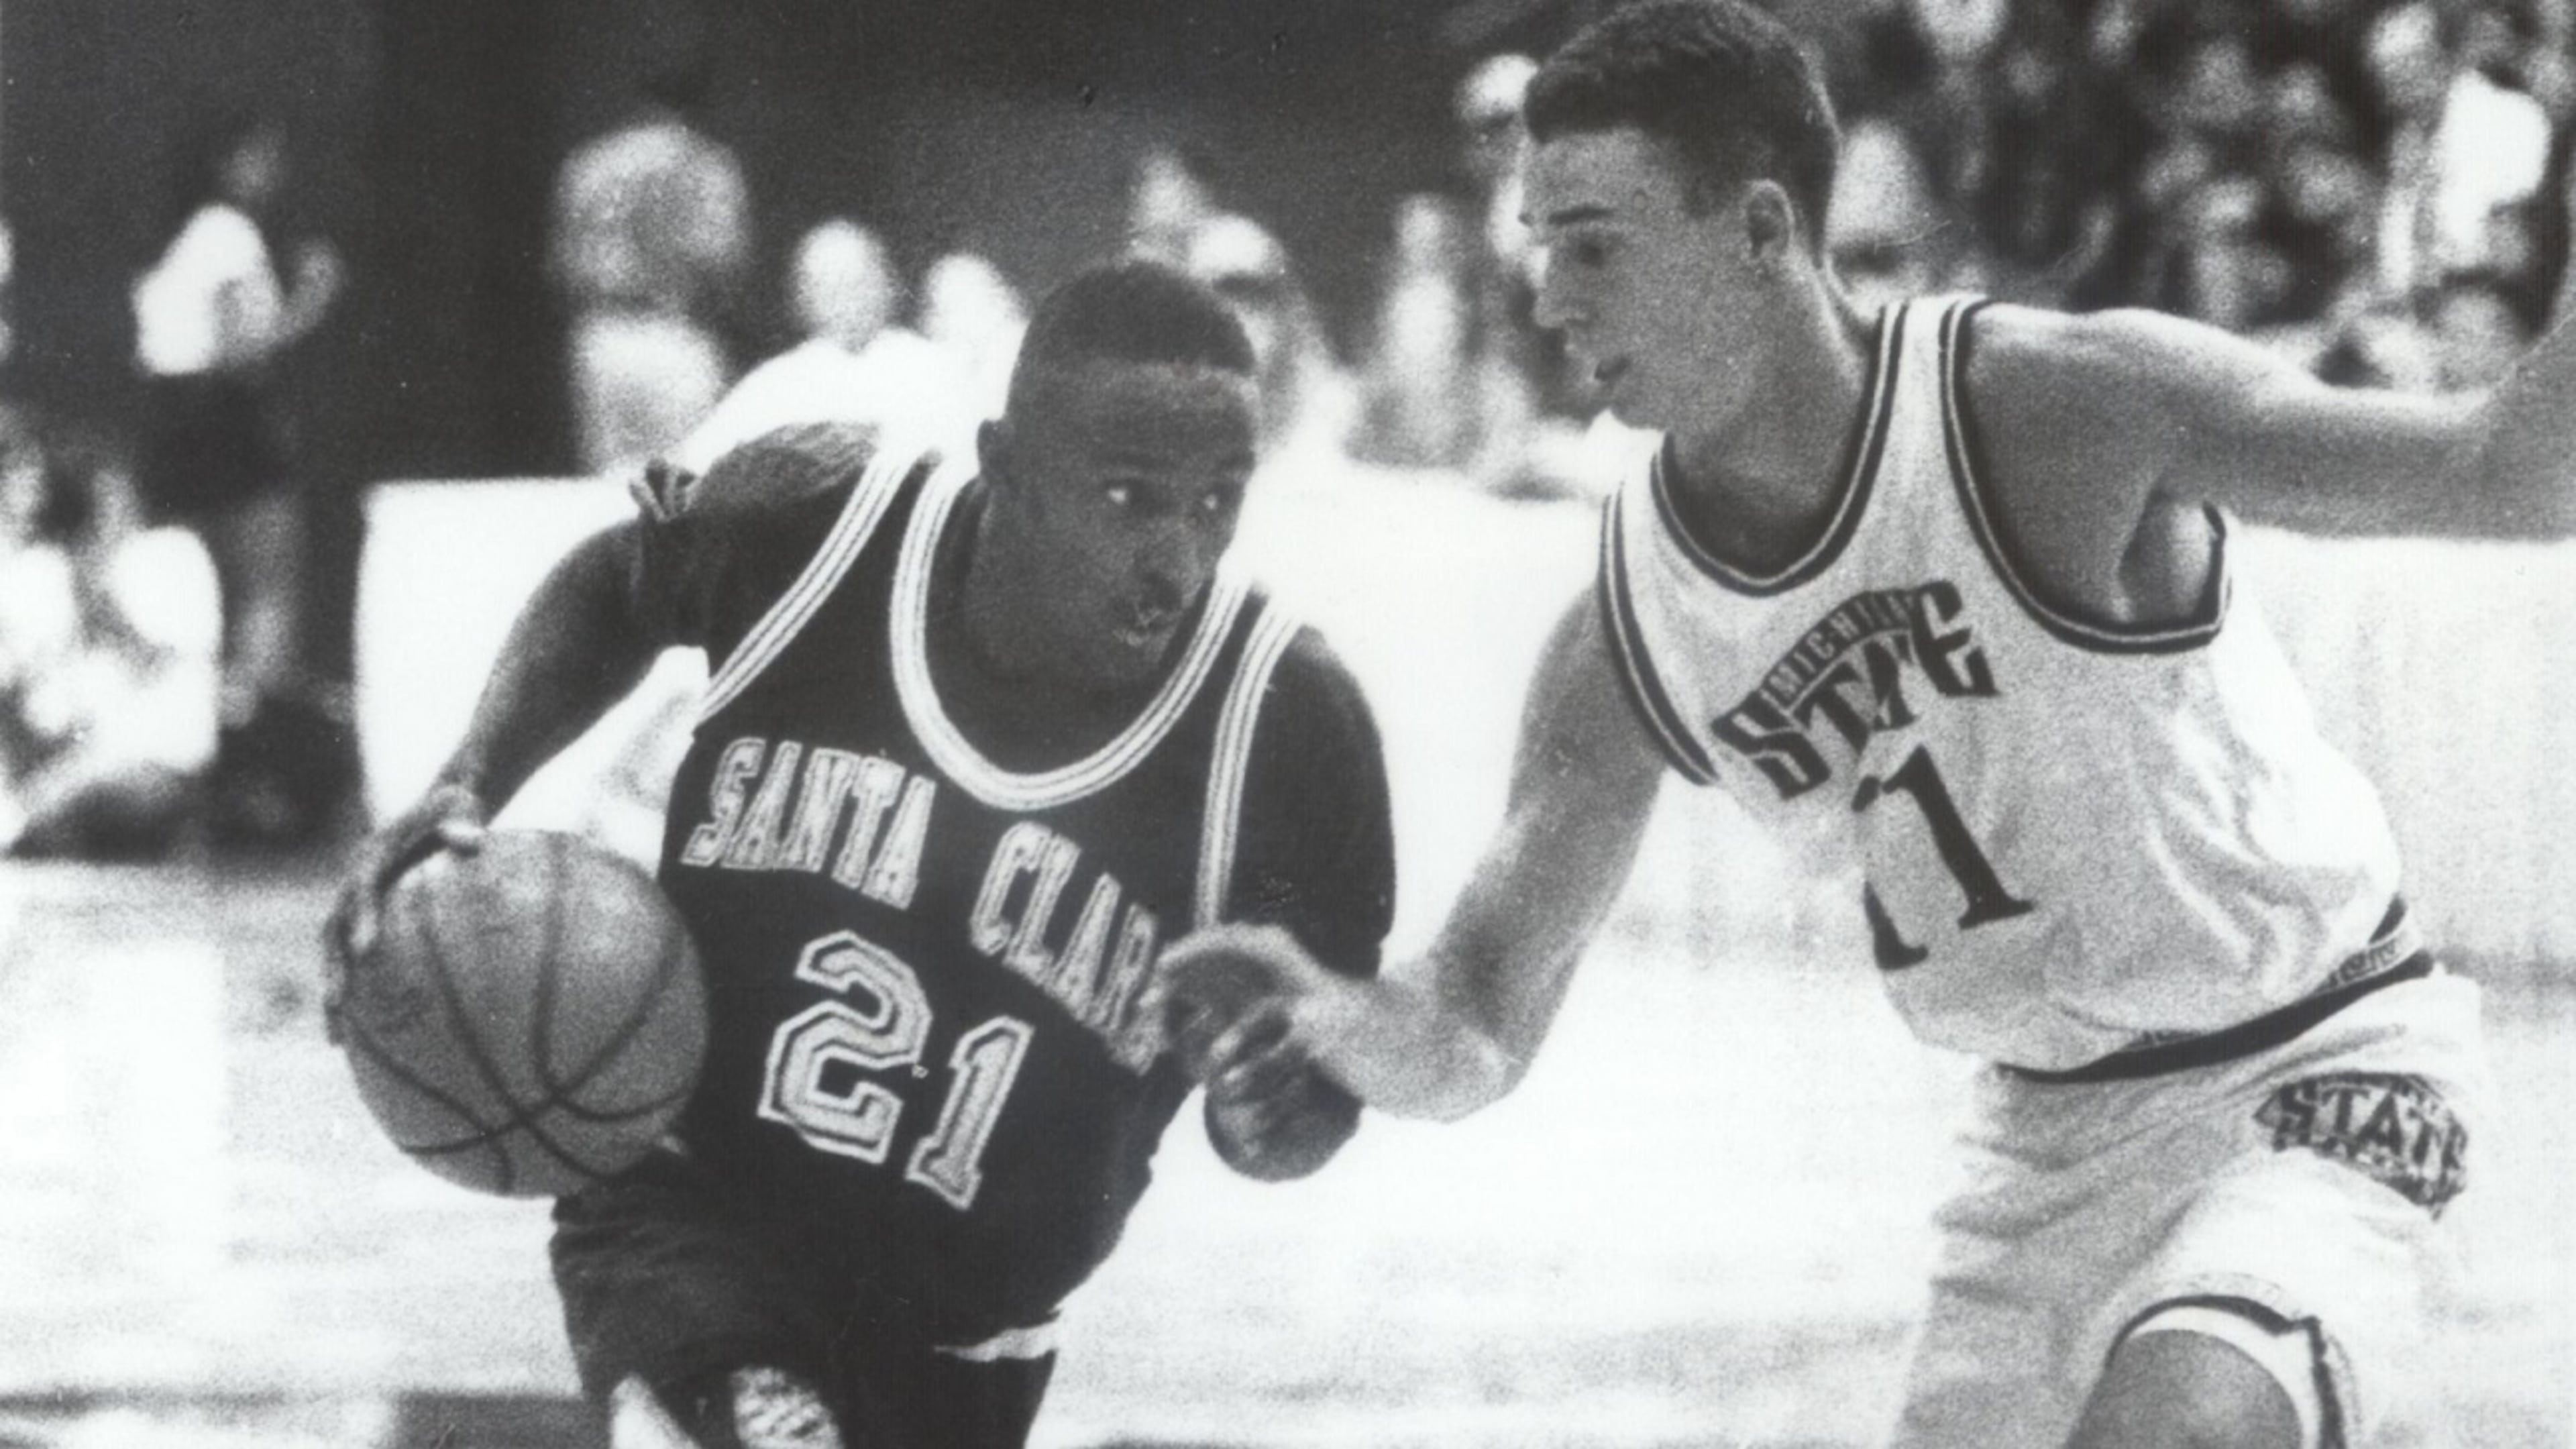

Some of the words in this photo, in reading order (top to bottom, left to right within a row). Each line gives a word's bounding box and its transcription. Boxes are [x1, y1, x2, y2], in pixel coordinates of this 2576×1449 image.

[1711, 581, 2000, 800] STAE
[680, 737, 937, 910] SANTA
[757, 930, 1035, 1210] 21
